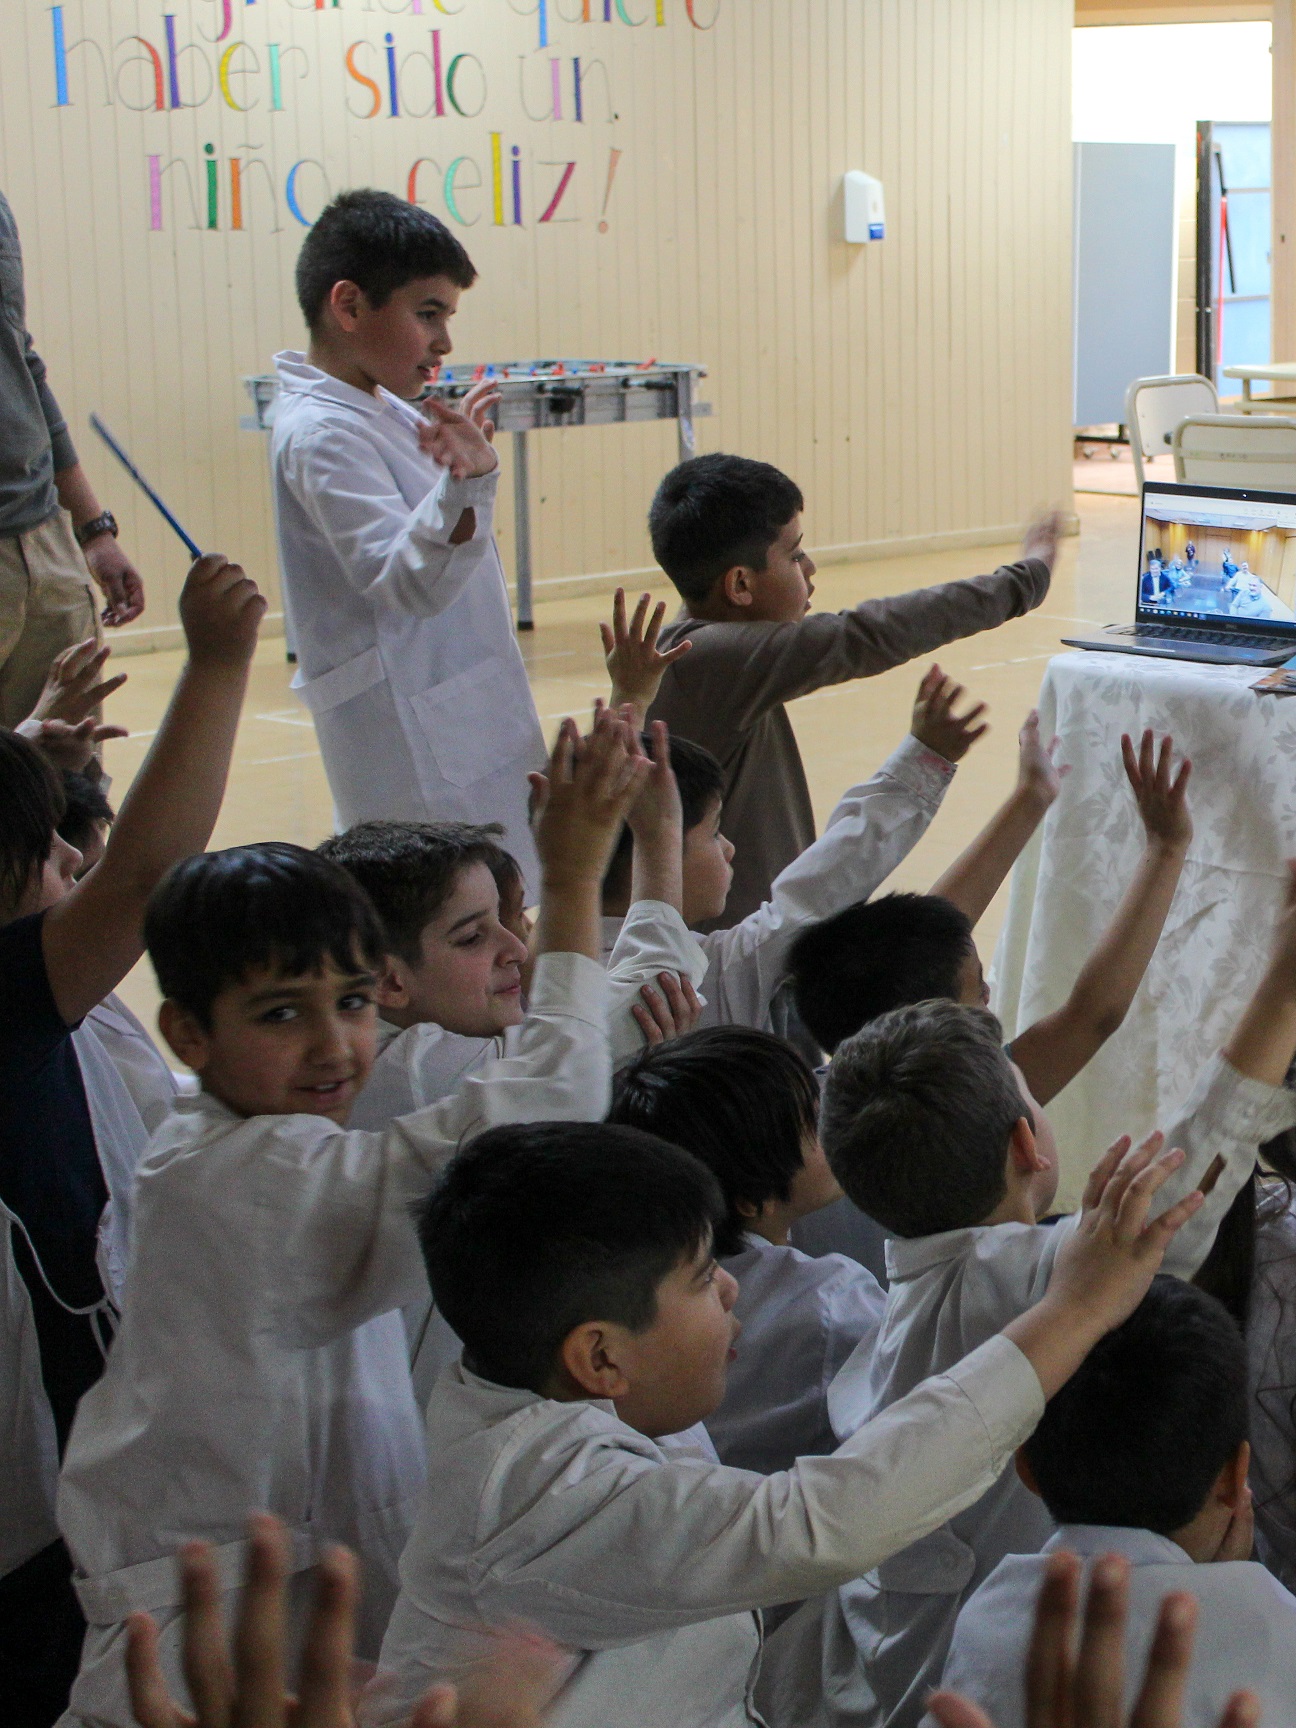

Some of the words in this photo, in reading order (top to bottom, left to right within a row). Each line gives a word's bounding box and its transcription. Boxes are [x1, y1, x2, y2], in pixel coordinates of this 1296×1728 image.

[46, 6, 310, 112] haber
[346, 29, 488, 119] sido
[145, 142, 331, 233] niño
